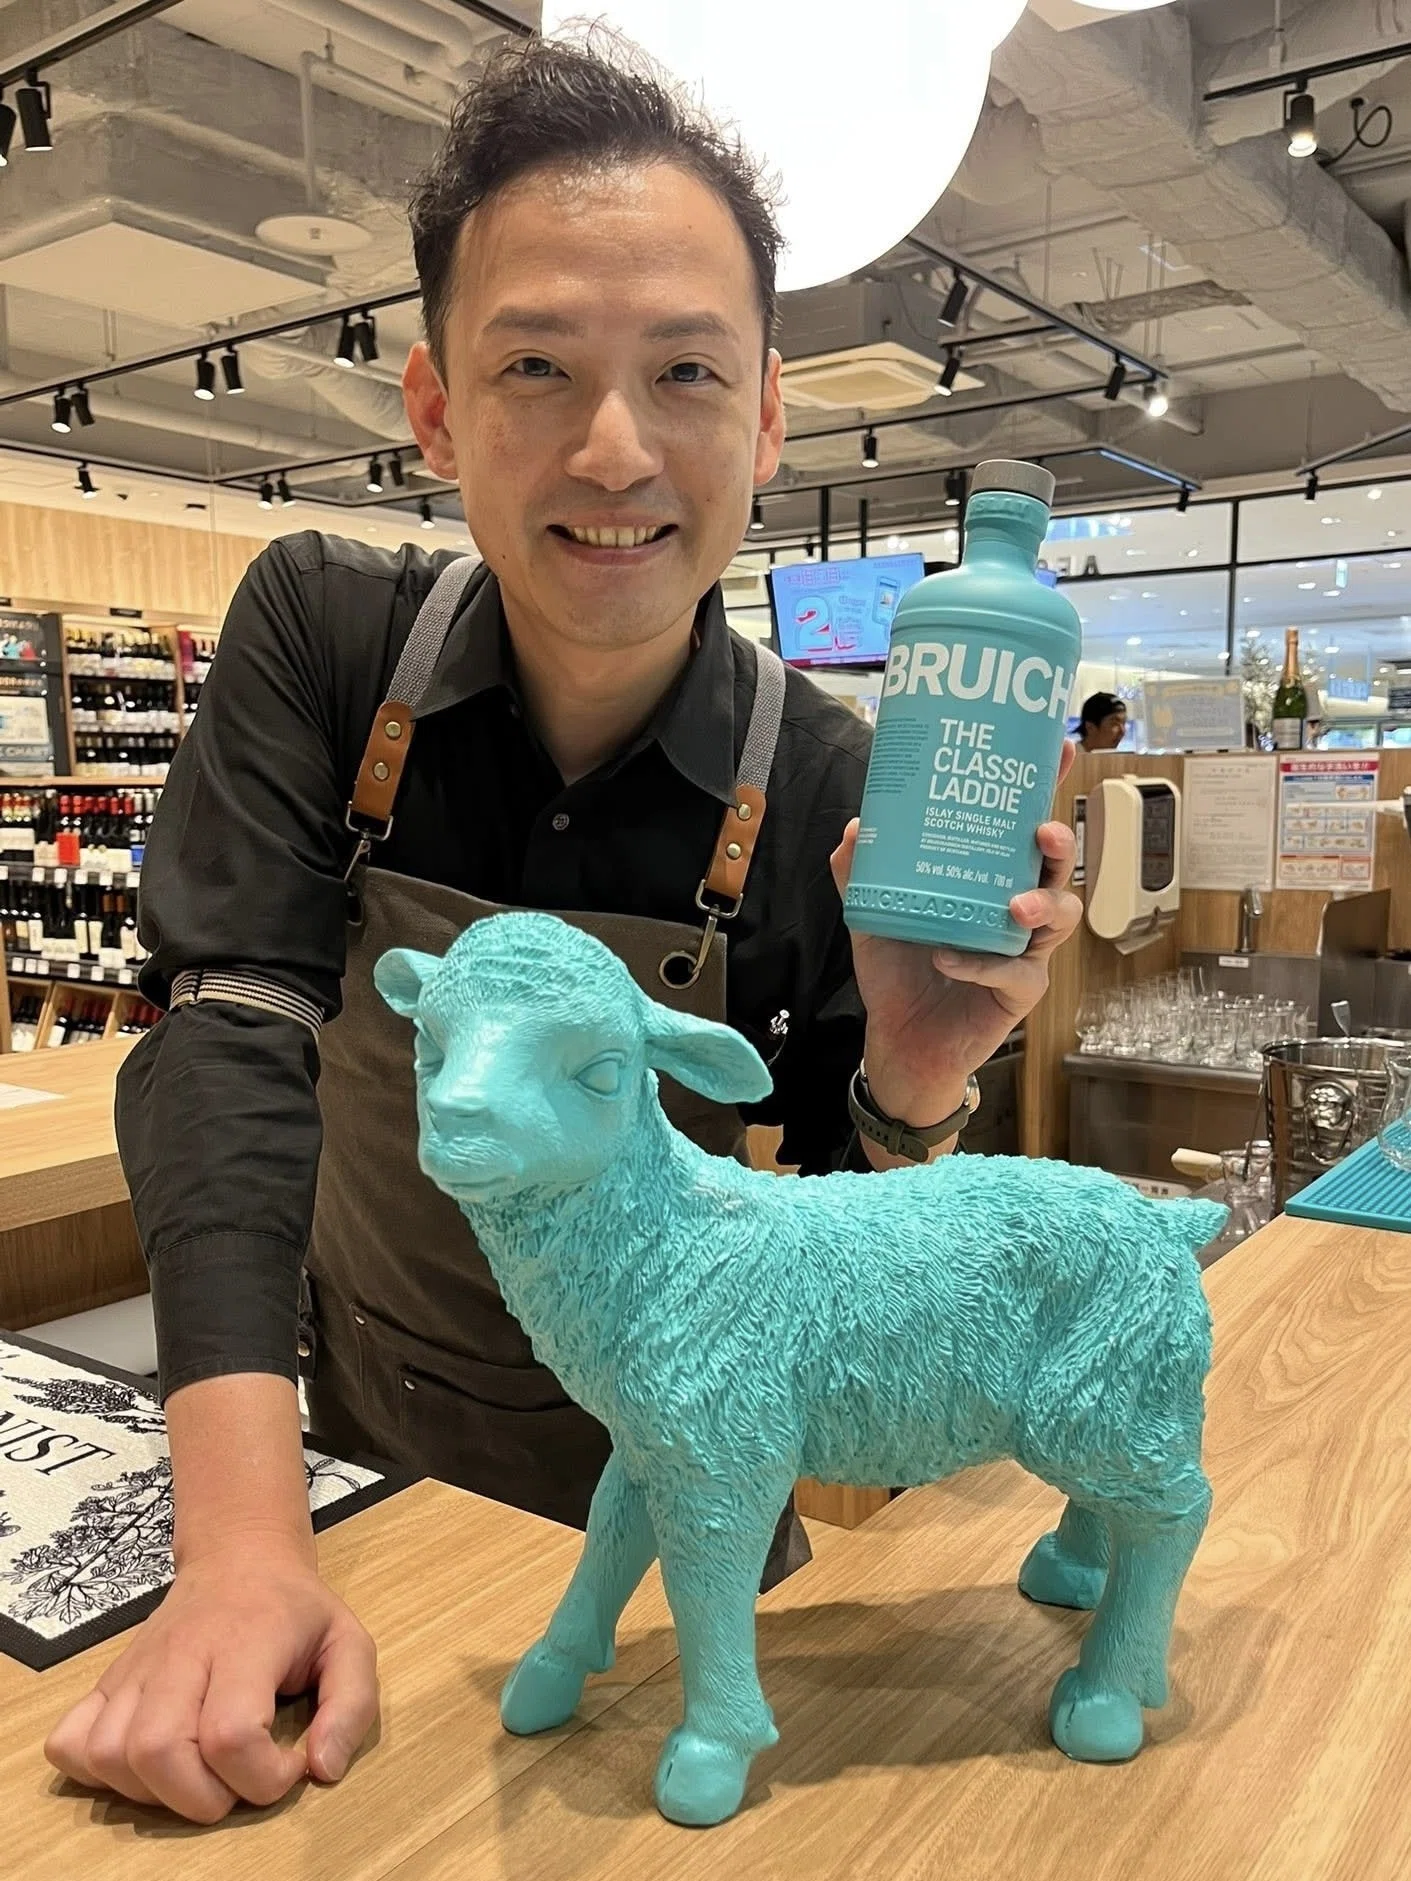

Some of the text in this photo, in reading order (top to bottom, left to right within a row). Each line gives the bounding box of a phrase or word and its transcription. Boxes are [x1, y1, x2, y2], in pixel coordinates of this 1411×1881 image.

[883, 642, 1074, 724] BRUICH
[940, 718, 995, 751] THE
[933, 746, 1038, 789] CLASSIC
[928, 774, 1022, 814] LADDIE
[923, 817, 1005, 839] SCOTCH WHISKY
[925, 806, 1017, 831] ISLAY SINGLE MALT
[915, 860, 932, 874] 50%
[945, 864, 962, 879] 50%
